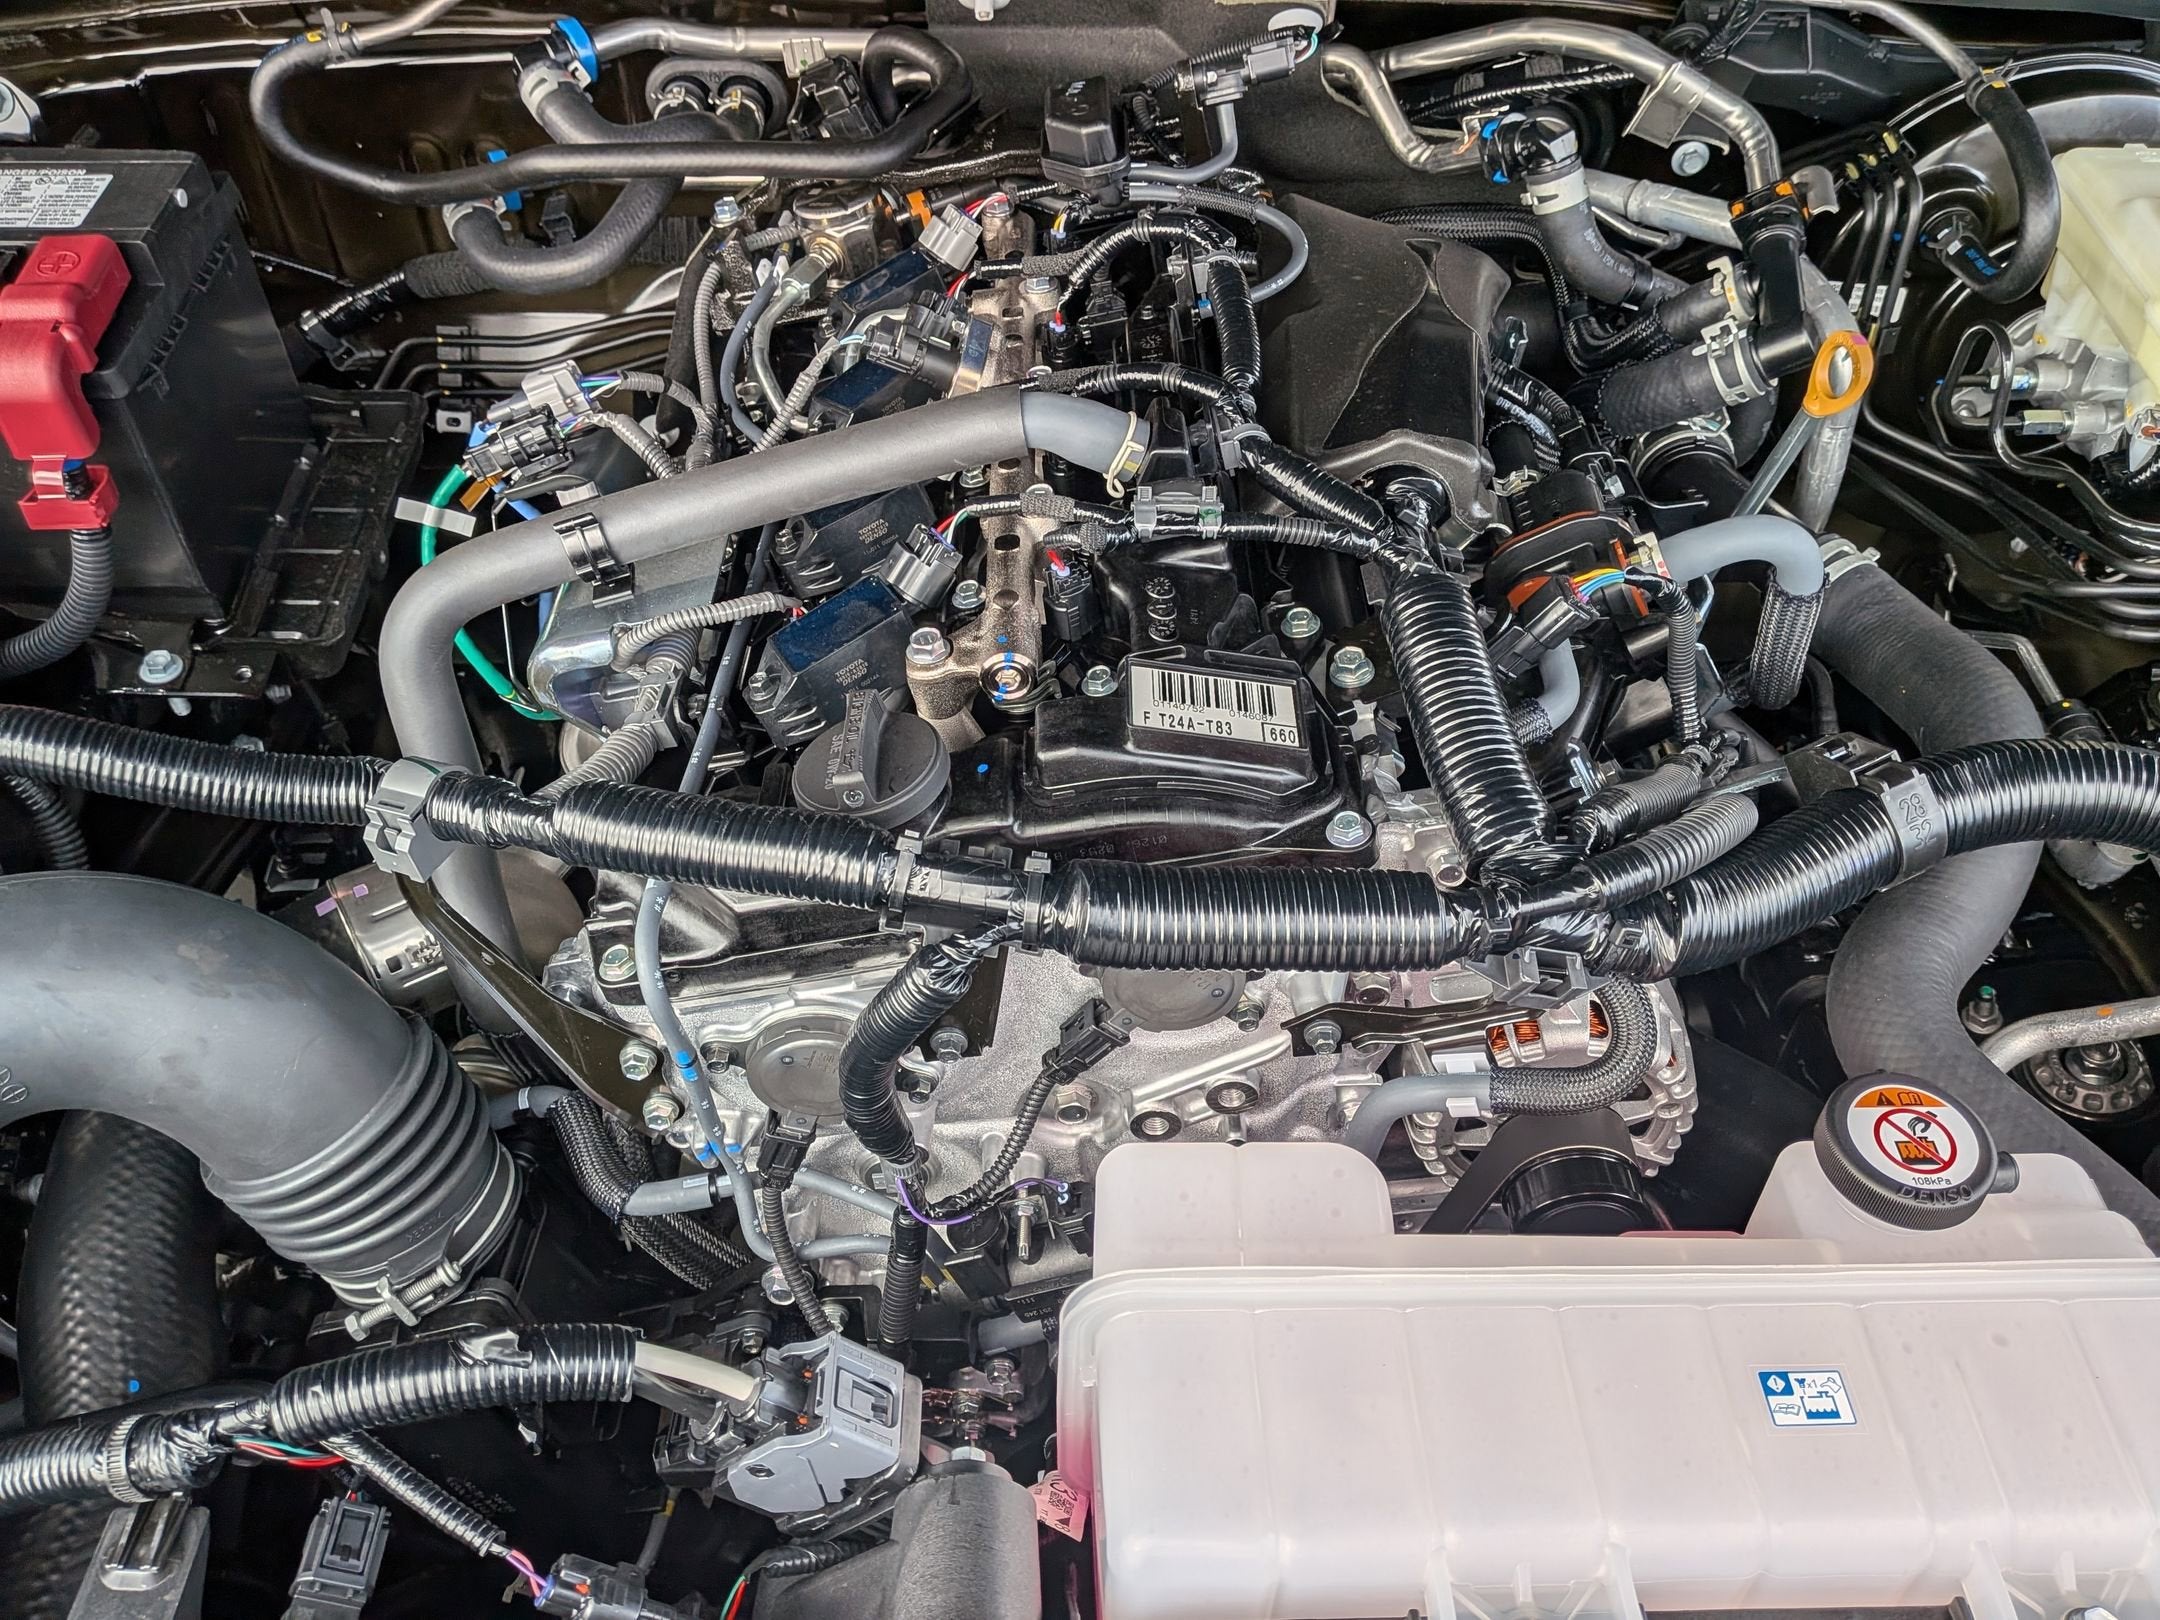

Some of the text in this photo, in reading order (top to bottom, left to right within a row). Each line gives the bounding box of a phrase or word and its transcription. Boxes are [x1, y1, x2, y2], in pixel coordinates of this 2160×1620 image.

[858, 518, 885, 535] TOYOTA
[864, 528, 888, 545] DENSO
[835, 658, 865, 677] TOYOTA
[842, 668, 868, 686] DENSO
[1153, 699, 1275, 722] 01140752 0146087
[1143, 711, 1297, 744] F T24A-T83 660
[831, 733, 844, 755] SAE
[1899, 792, 1927, 825] 28
[1909, 818, 1937, 850] 32
[1911, 1176, 1953, 1187] 108kPa
[1896, 1184, 1974, 1206] DENSO
[1806, 1379, 1818, 1389] x1
